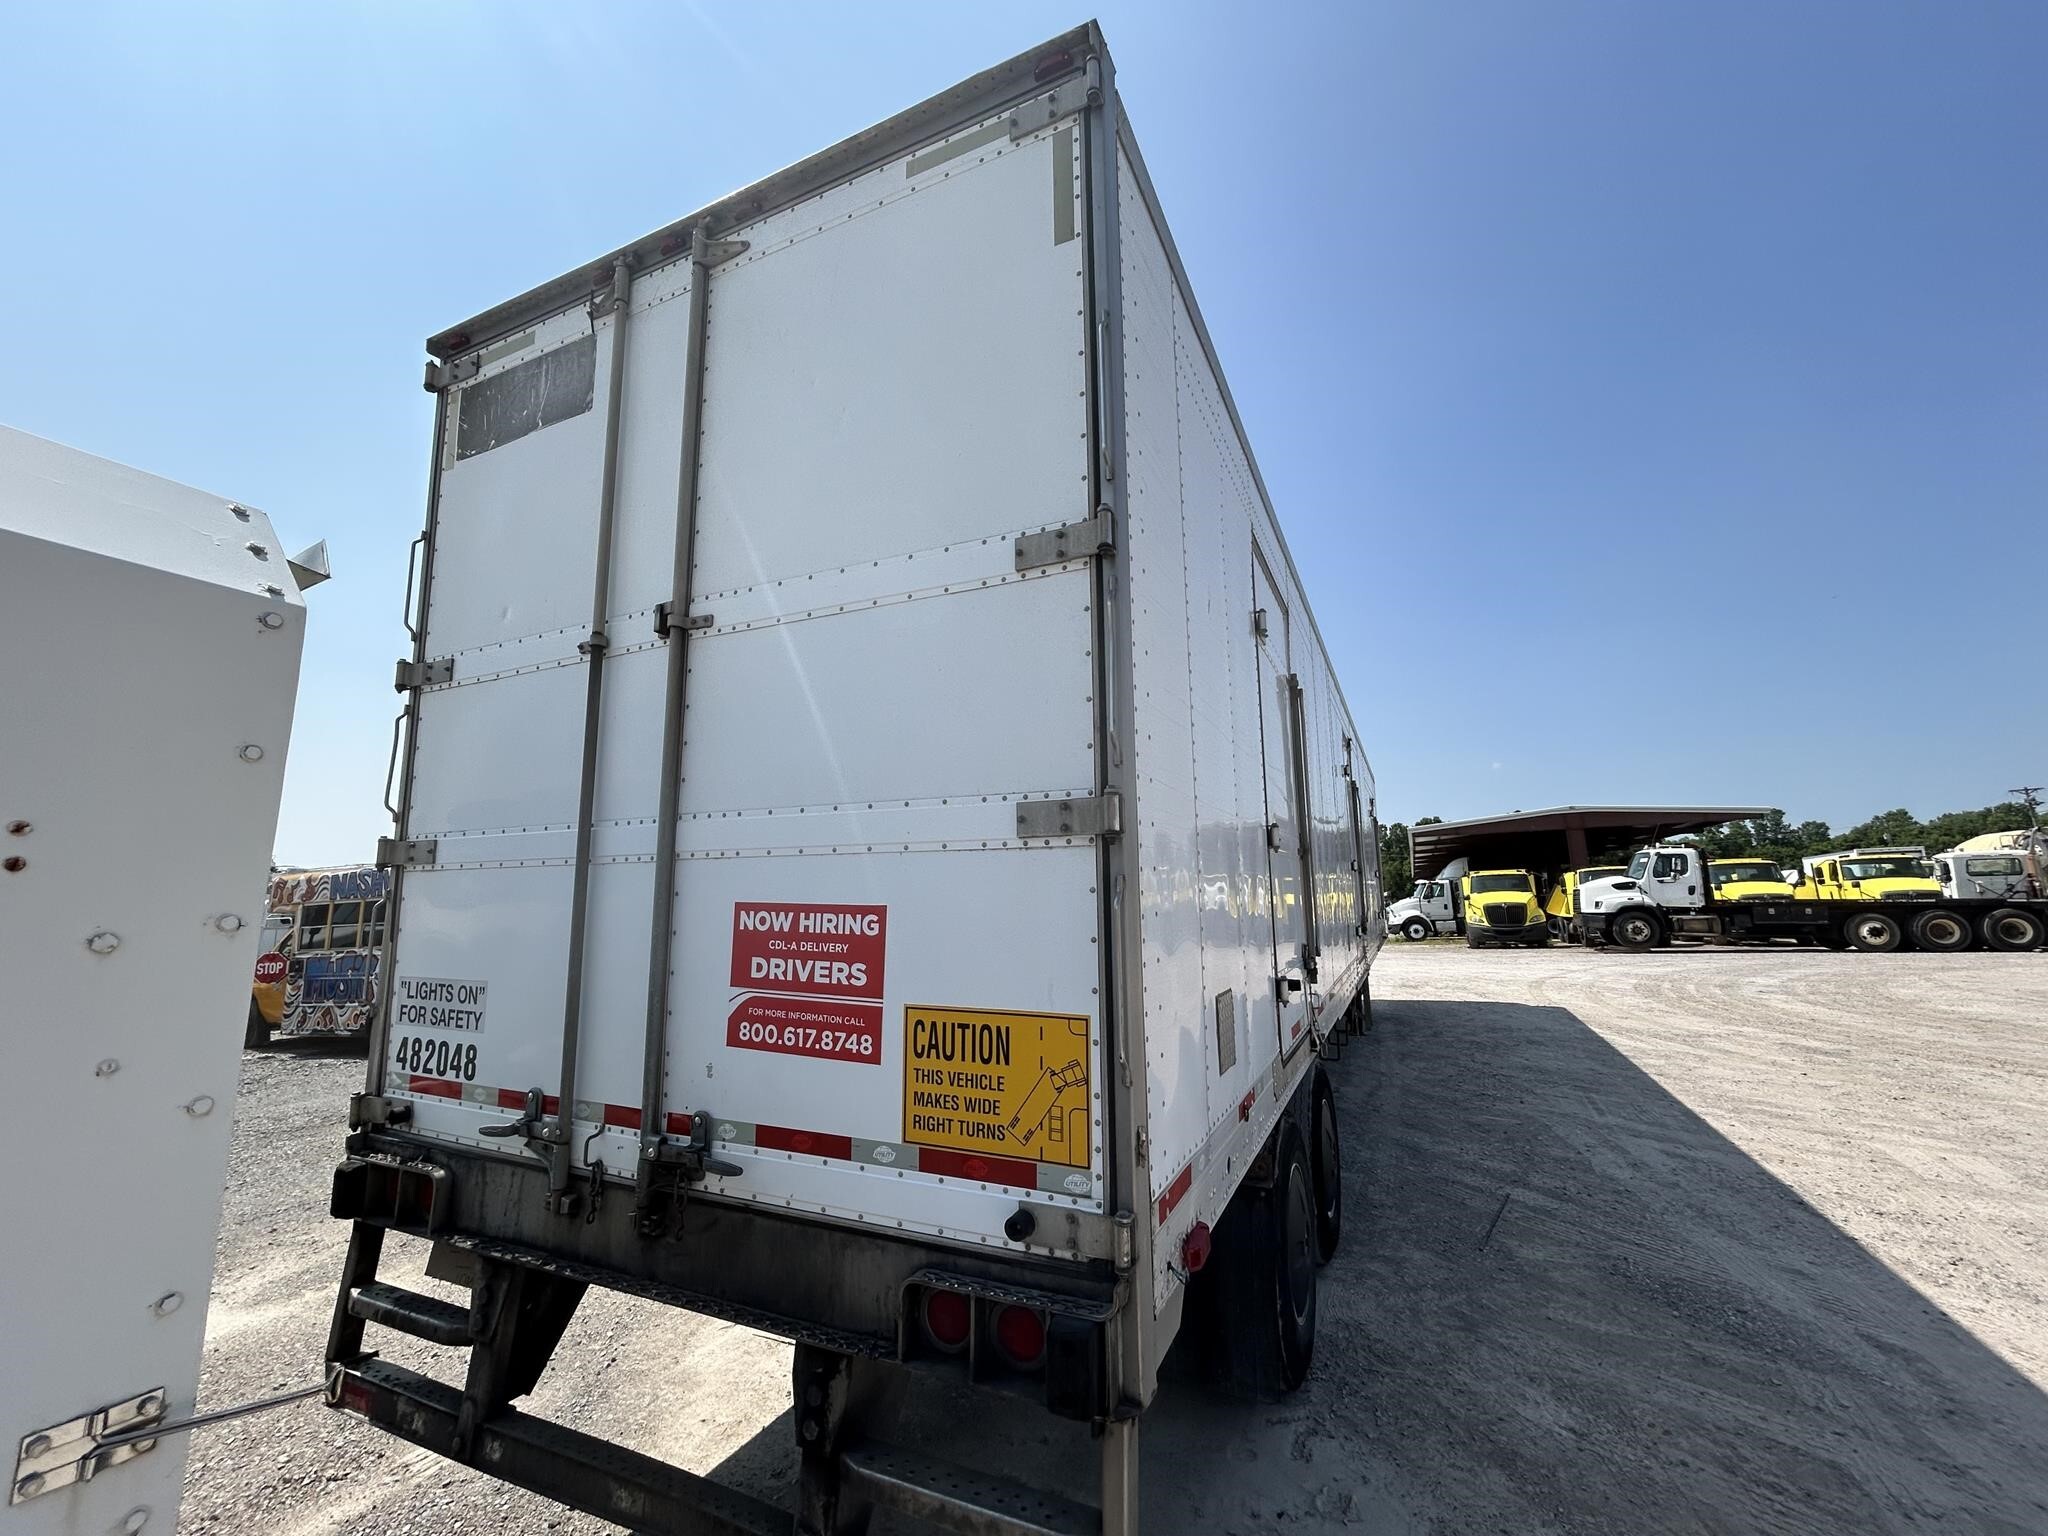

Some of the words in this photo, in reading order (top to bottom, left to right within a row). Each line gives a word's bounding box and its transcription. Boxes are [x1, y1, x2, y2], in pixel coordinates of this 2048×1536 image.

[739, 910, 794, 932] NOW
[798, 912, 880, 936] HIRING
[768, 940, 798, 951] CDL-A
[800, 941, 849, 953] DELIVERY
[256, 962, 284, 975] STOP
[750, 956, 868, 987] DRIVERS
[401, 980, 454, 1003] "LIGHTS
[457, 984, 486, 1005] ON"
[399, 1004, 427, 1024] FOR
[429, 1006, 483, 1031] SAFETY
[748, 1007, 763, 1016] FOR
[765, 1009, 787, 1018] MORE
[788, 1011, 843, 1025] INFORMATION
[844, 1016, 866, 1027] CALL
[739, 1021, 873, 1055] 800.617.8748
[913, 1018, 1010, 1066] CAUTION
[396, 1036, 478, 1082] 482048
[913, 1067, 944, 1086] THIS
[947, 1070, 1006, 1092] VEHICLE
[913, 1091, 960, 1111] MAKES
[963, 1095, 1001, 1116] WIDE
[912, 1113, 954, 1134] RIGHT
[957, 1119, 1006, 1141] TURNS
[1065, 1179, 1090, 1188] UTILITY
